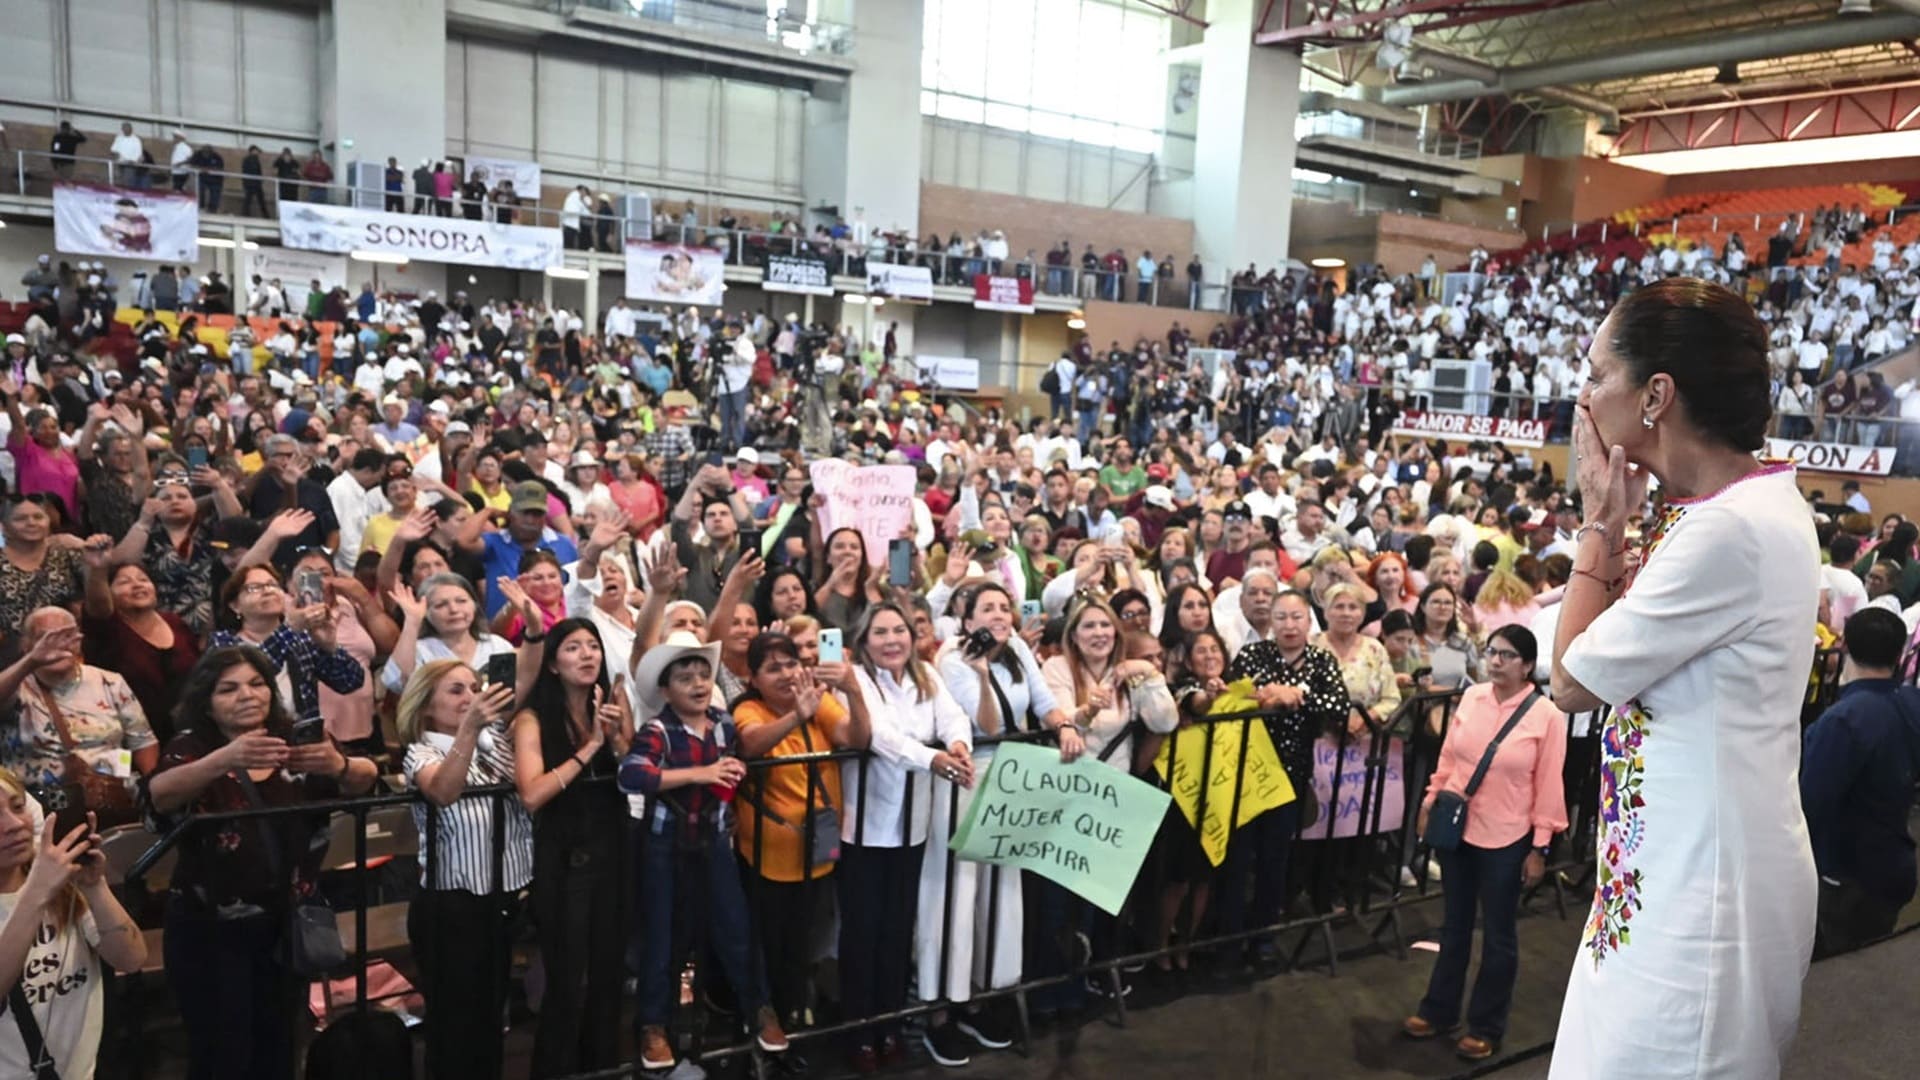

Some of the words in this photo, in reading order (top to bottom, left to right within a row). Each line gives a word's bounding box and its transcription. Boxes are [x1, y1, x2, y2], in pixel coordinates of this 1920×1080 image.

[365, 222, 490, 255] SONORA
[1469, 416, 1493, 435] SE
[1495, 418, 1546, 441] PAGA
[1788, 443, 1851, 468] CON
[1859, 447, 1882, 472] A
[997, 758, 1119, 808] CLAUDIA
[980, 804, 1064, 829] MUJER
[1075, 812, 1125, 849] QUE
[985, 834, 1091, 874] INSPIRA
